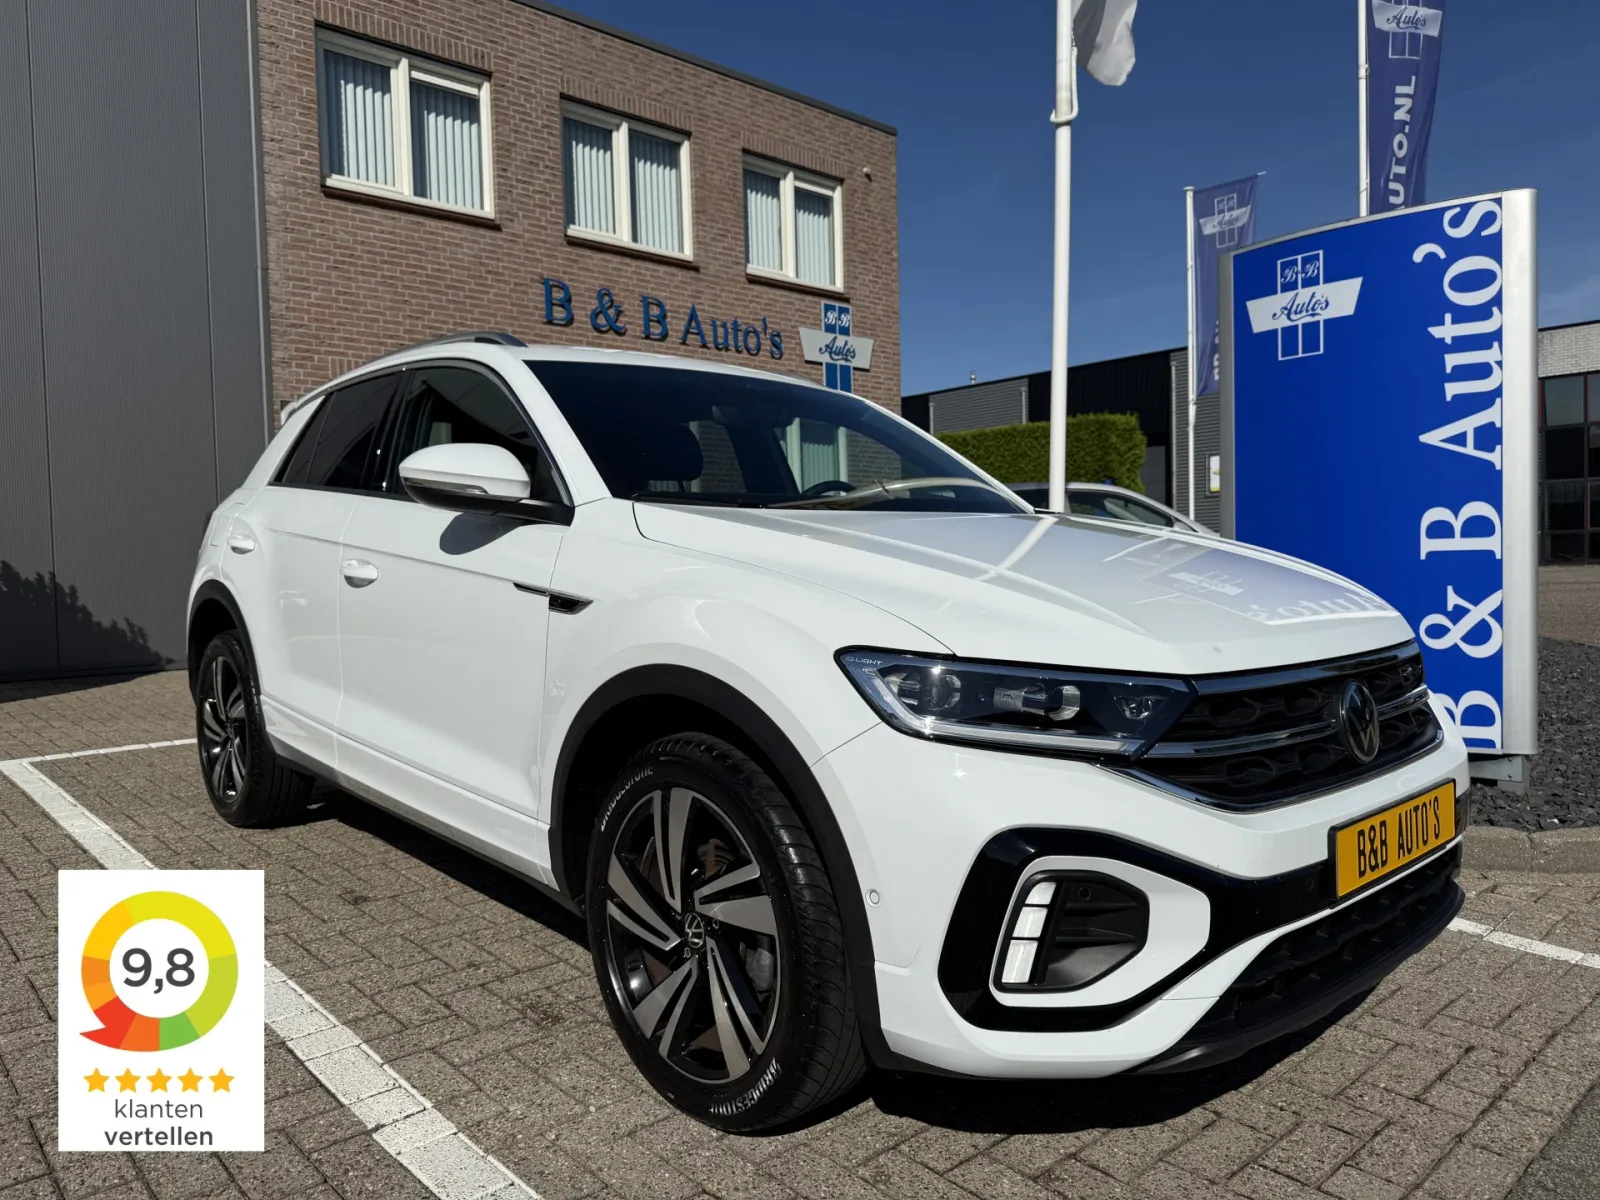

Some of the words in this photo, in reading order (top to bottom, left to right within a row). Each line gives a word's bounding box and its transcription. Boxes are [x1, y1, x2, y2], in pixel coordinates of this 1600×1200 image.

[1388, 75, 1416, 209] UTO.NL
[541, 277, 574, 325] B
[590, 287, 626, 335] &
[640, 295, 669, 340] B
[680, 303, 785, 359] Auto's
[1272, 291, 1330, 322] Auto's
[1412, 200, 1503, 470] Auto's
[819, 335, 856, 362] Auto's
[1420, 500, 1502, 560] B
[1419, 585, 1503, 659] &
[1357, 820, 1388, 879] B&B
[1397, 795, 1440, 860] AUTO'S
